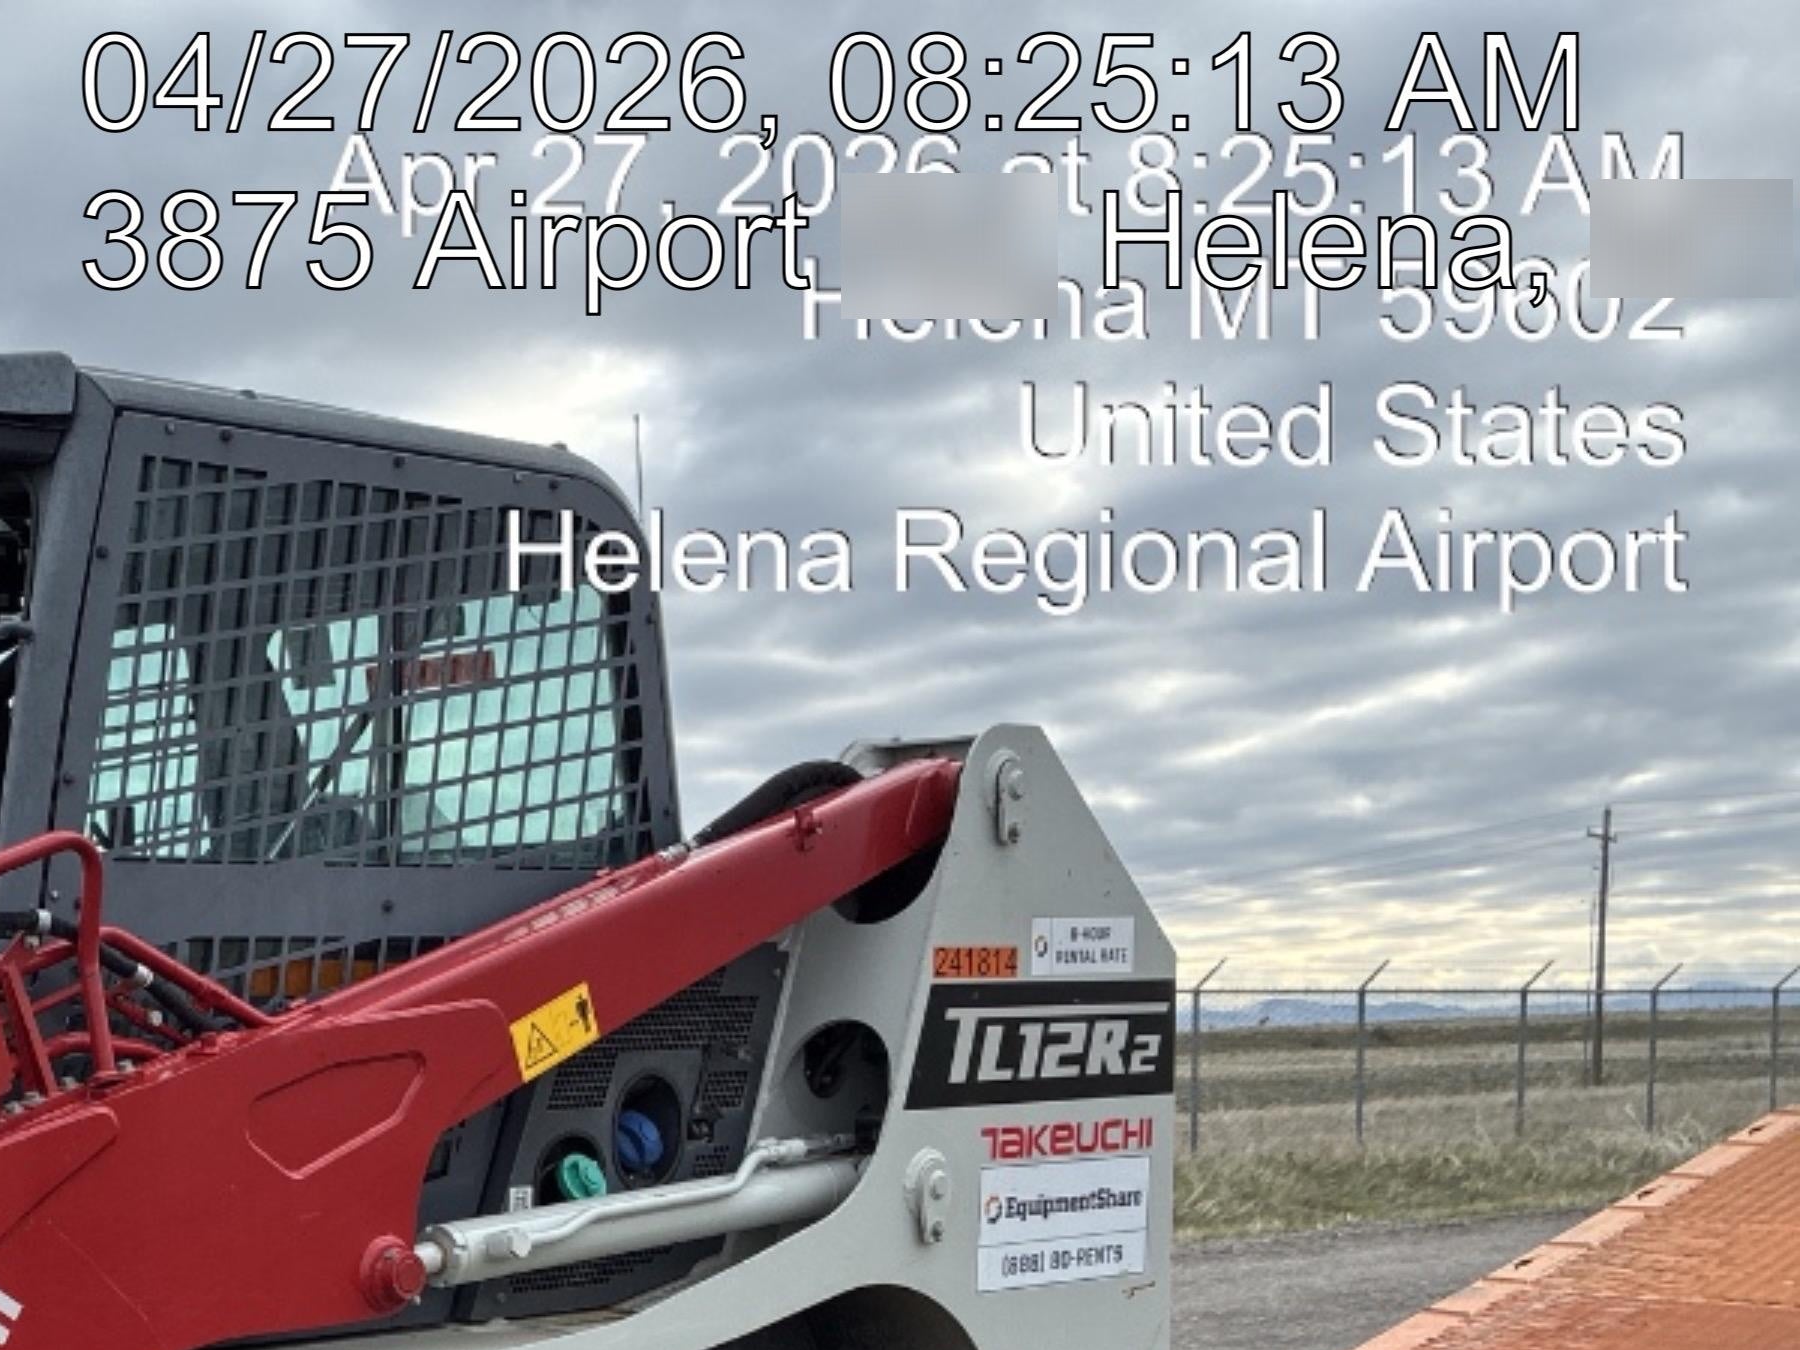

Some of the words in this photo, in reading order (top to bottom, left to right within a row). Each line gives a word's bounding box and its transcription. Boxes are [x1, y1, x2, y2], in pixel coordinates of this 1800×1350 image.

[934, 946, 1018, 977] 241814
[945, 1002, 1170, 1084] TL12R2
[1004, 1187, 1143, 1222] EquipmentShare
